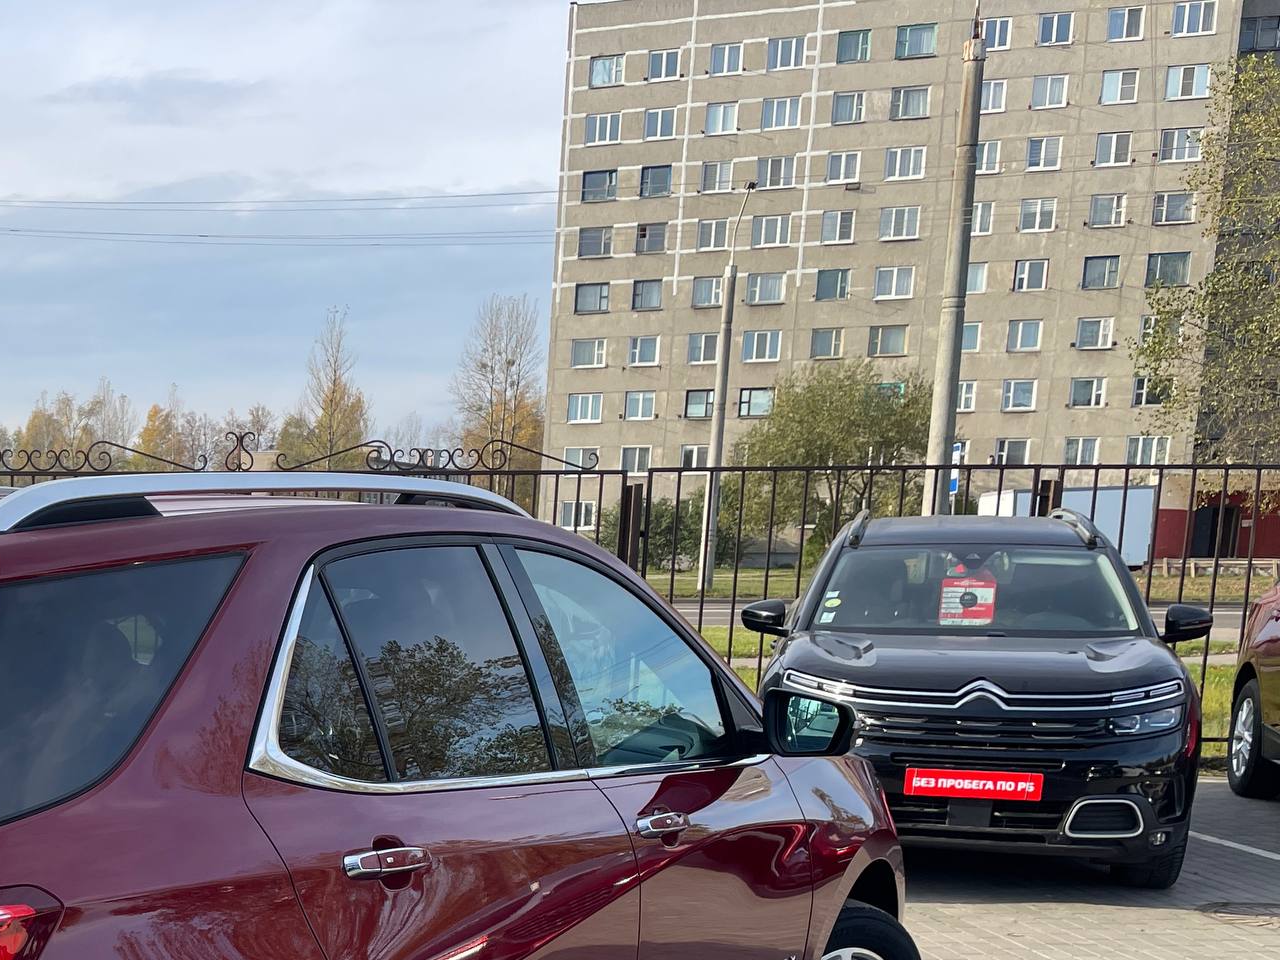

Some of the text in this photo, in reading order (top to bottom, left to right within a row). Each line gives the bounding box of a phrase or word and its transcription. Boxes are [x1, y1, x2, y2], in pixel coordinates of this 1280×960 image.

[913, 777, 1035, 792] БЕЗ ПРОБЕГА ПО РБ
